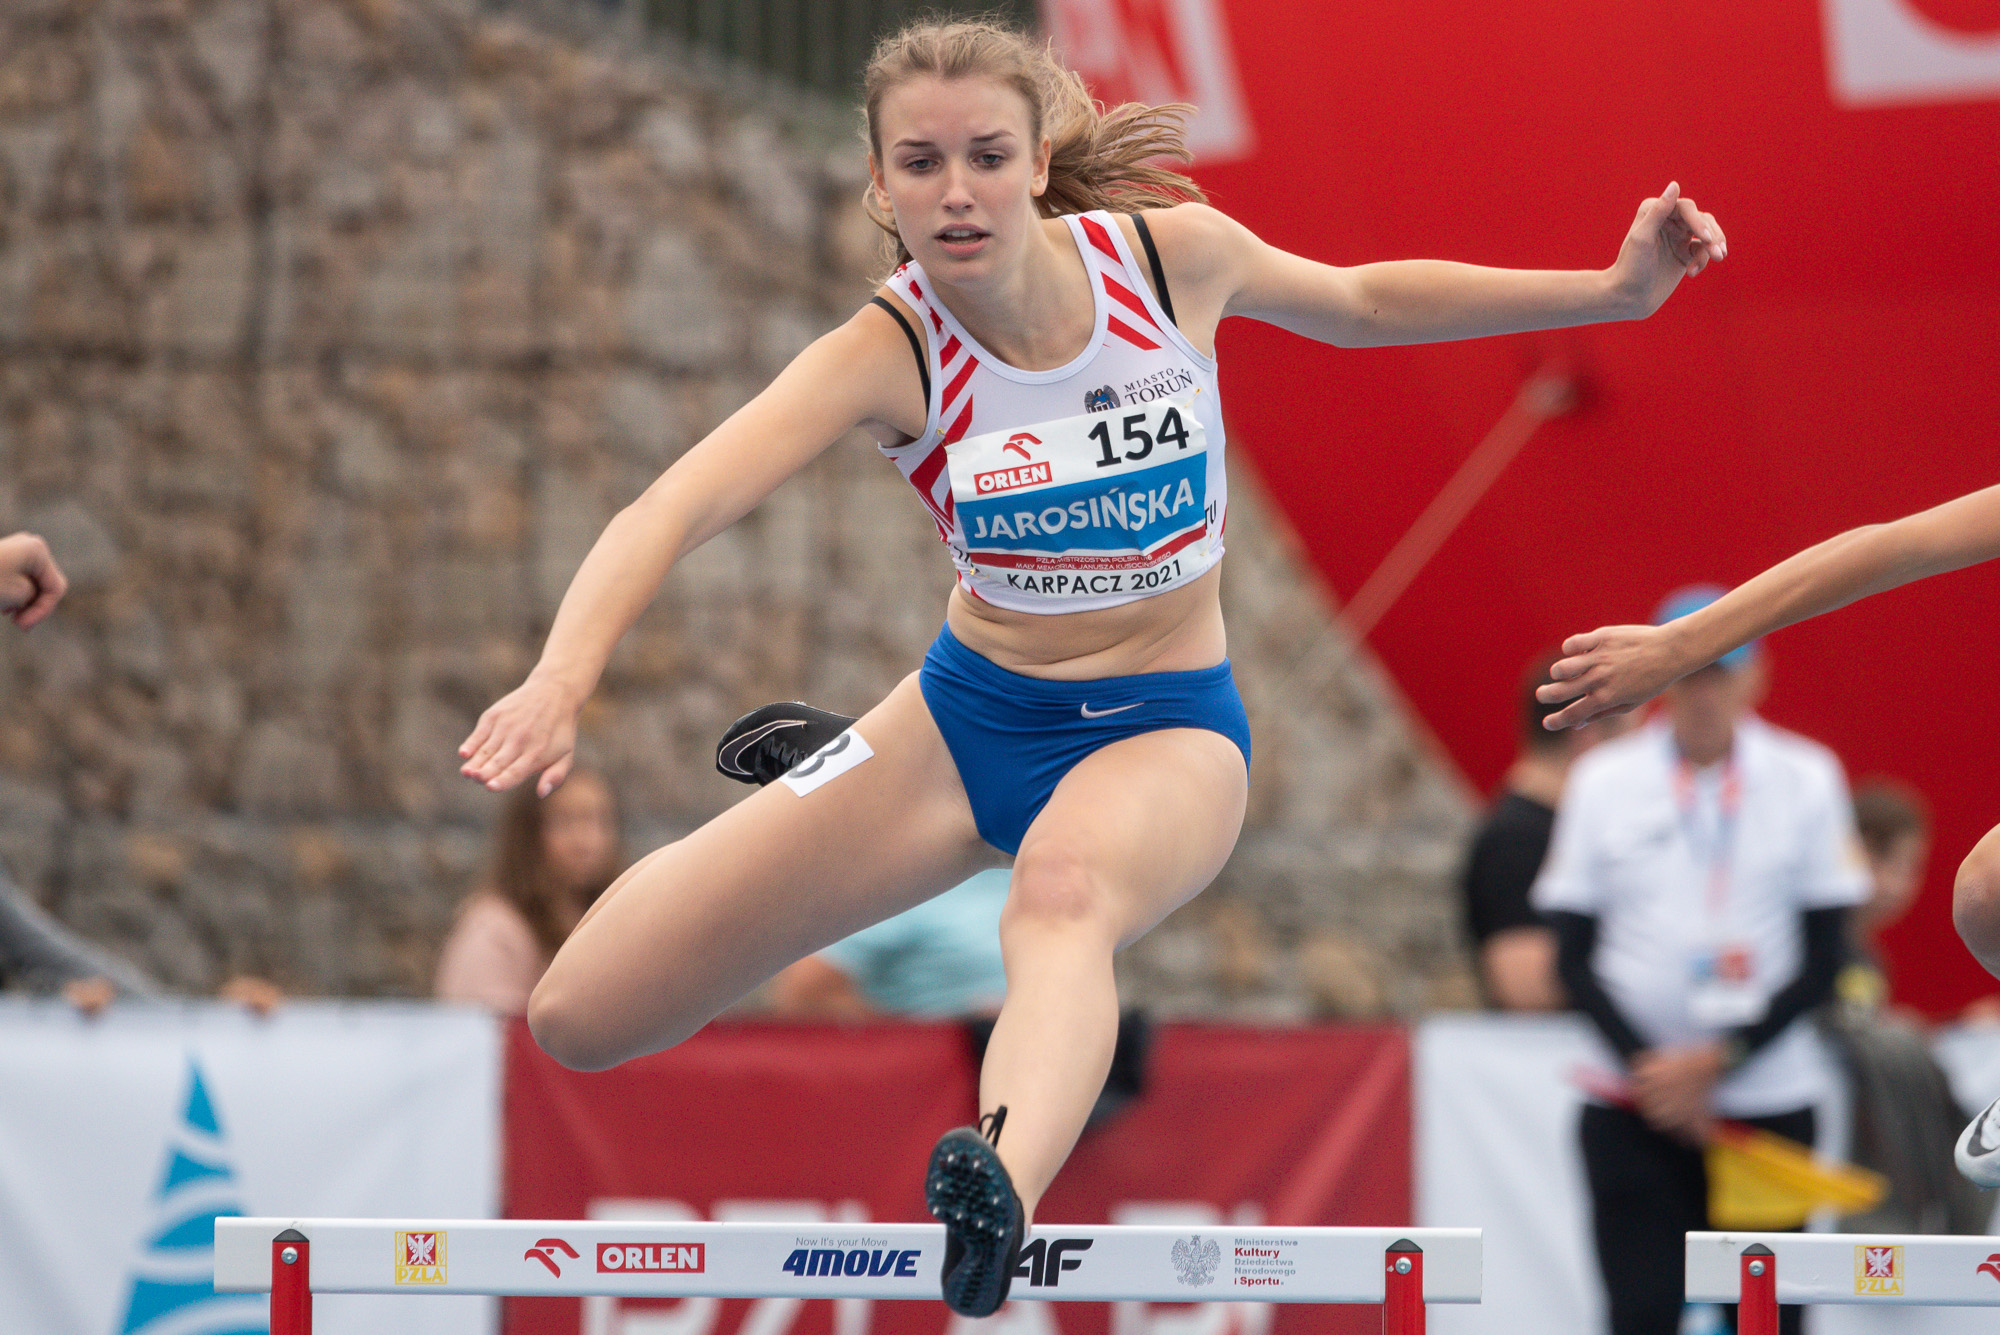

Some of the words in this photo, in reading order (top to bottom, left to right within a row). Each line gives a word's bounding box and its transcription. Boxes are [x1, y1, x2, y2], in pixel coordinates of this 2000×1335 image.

[1124, 368, 1174, 392] MIASTO
[1125, 368, 1193, 405] TORUŃ
[1088, 407, 1189, 468] 154
[978, 464, 1048, 492] ORLEN
[974, 477, 1195, 540] JAROSIŃSKA
[1078, 562, 1115, 571] JANUSZA
[1112, 555, 1140, 563] POLSKI
[1007, 573, 1123, 595] KARPACZ
[1130, 559, 1182, 591] 2021
[795, 1237, 818, 1247] Now
[820, 1237, 834, 1247] It's
[837, 1239, 859, 1249] your
[861, 1237, 888, 1247] Move
[601, 1246, 699, 1270] ORLEN
[1234, 1247, 1280, 1259] Kultury
[1234, 1258, 1294, 1267] Dziedzictwa
[782, 1249, 921, 1277] 4MOVE
[1234, 1267, 1296, 1277] Narodowego
[397, 1267, 444, 1282] PZLA
[1857, 1278, 1901, 1293] PZLA
